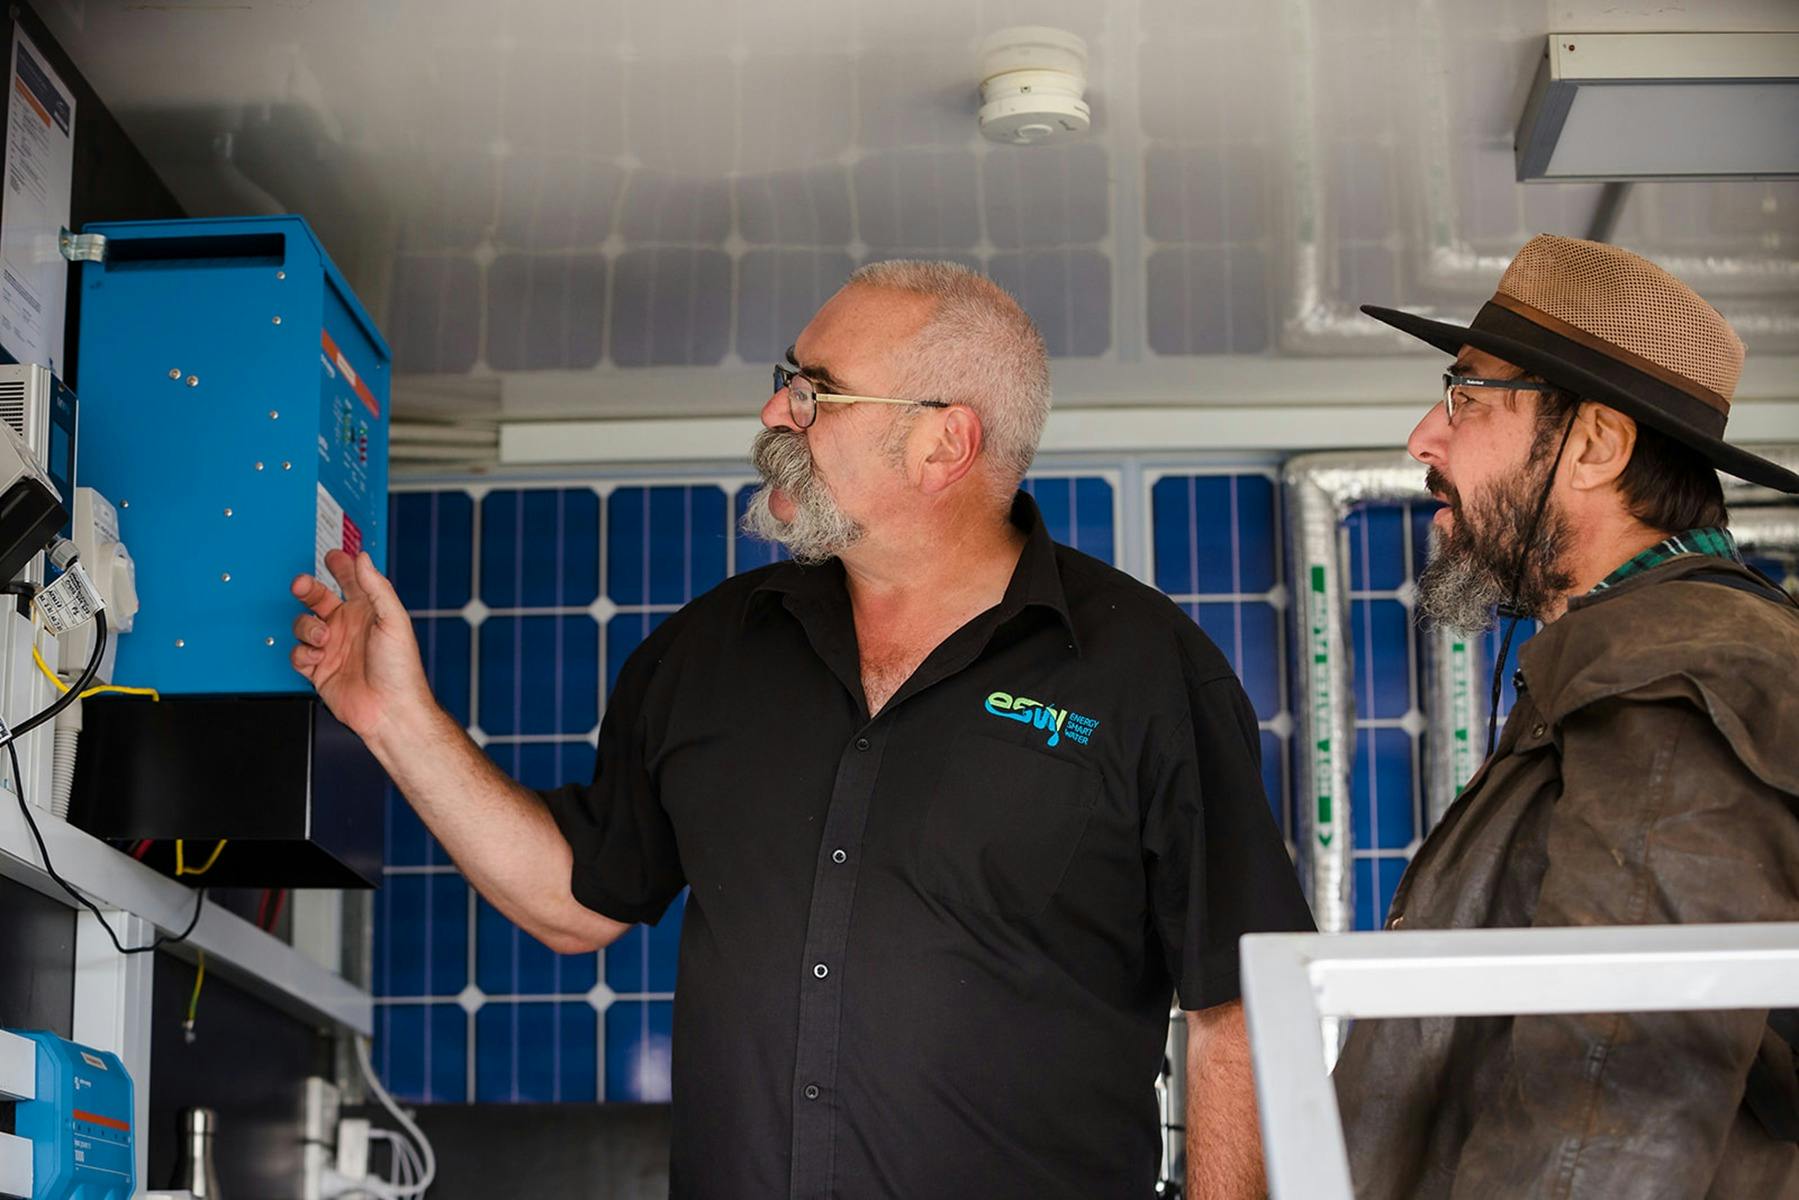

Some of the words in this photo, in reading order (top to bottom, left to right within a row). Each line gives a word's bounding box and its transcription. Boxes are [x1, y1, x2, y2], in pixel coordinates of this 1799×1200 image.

[1066, 720, 1094, 737] SMART
[1069, 713, 1100, 729] ENERGY
[1064, 728, 1089, 745] WATER
